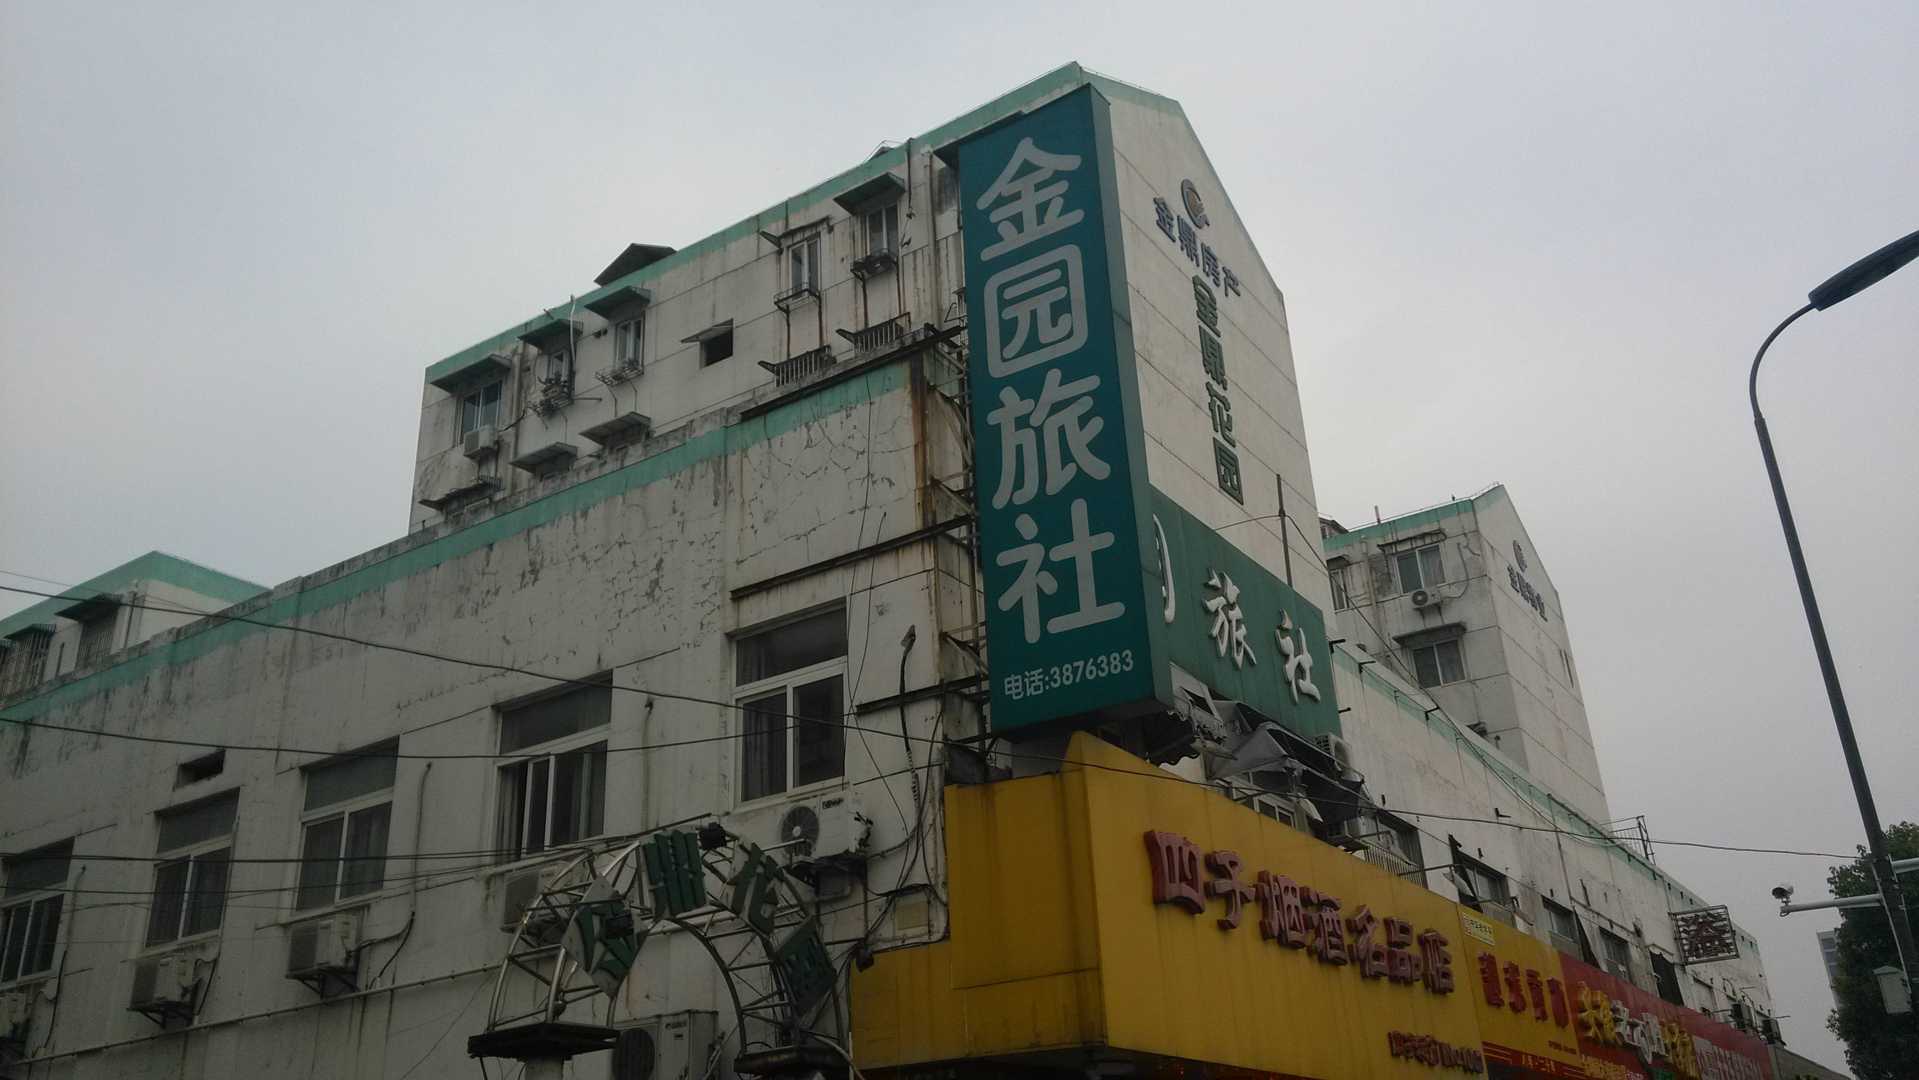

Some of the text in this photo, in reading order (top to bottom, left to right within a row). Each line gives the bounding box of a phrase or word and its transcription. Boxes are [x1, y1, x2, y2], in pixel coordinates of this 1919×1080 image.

[976, 136, 1126, 645] 金园旅社
[1003, 649, 1135, 701] 电话:3876383
[1143, 829, 1454, 995] 四子烟酒名品店
